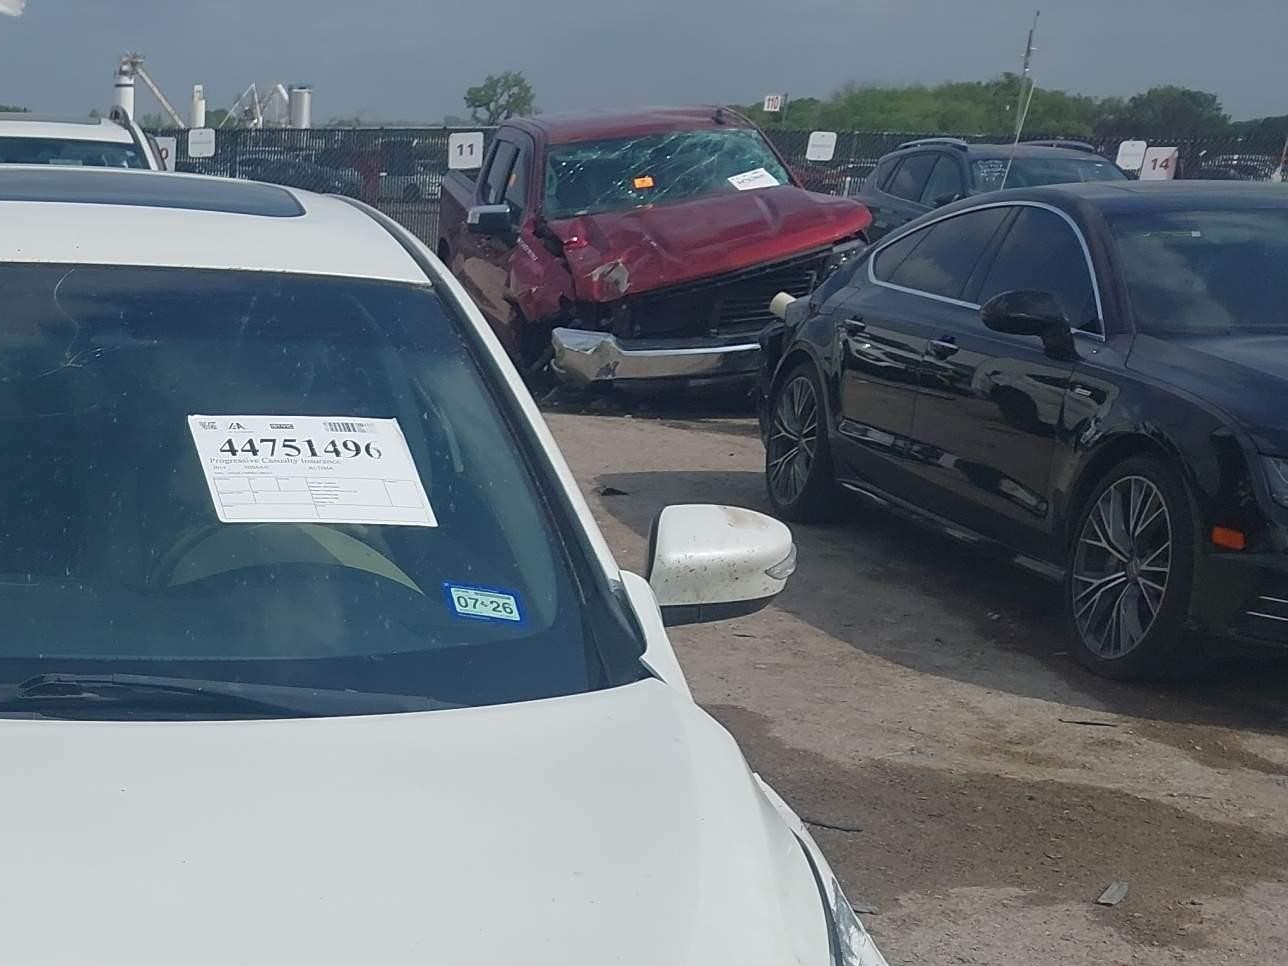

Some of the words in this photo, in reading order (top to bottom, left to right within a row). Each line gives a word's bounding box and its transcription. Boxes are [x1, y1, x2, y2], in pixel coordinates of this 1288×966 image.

[456, 143, 474, 156] 11
[1151, 158, 1170, 171] 14
[219, 438, 383, 460] 44751496
[210, 457, 259, 466] Progressive
[261, 457, 298, 465] Casualty
